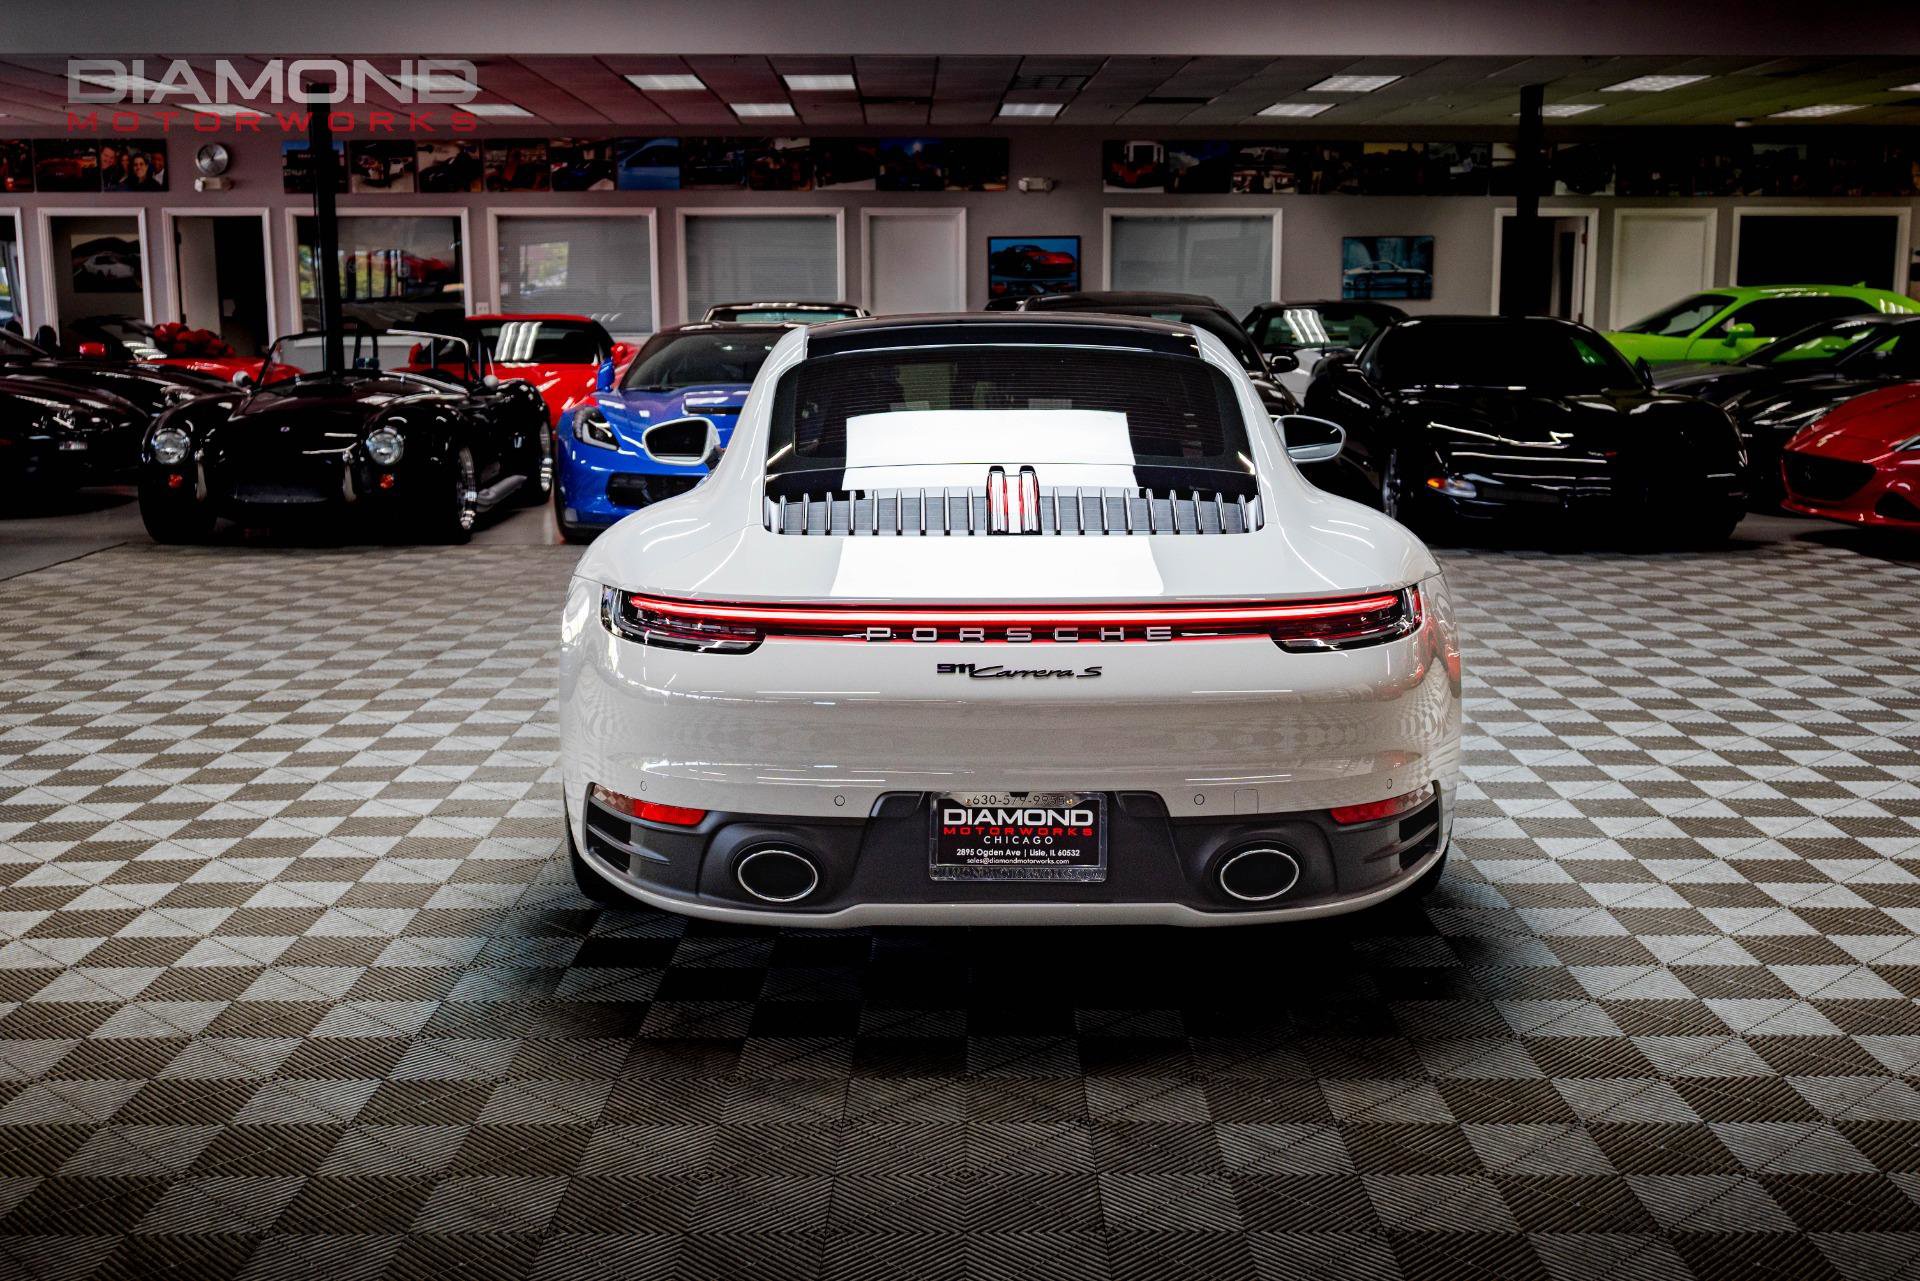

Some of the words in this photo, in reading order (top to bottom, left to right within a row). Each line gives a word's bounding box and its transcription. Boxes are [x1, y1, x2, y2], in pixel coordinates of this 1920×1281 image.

[866, 626, 1172, 642] PORSCHE
[971, 665, 1074, 678] Carrera
[1076, 666, 1102, 679] S
[943, 808, 1094, 826] DIAMOND
[943, 827, 1093, 836] MOTORWORKS
[983, 836, 1053, 845] CHICAGO
[956, 849, 975, 857] 2895
[976, 849, 1004, 858] Ogden
[1005, 849, 1021, 857] Ave
[1057, 849, 1080, 857] 60532
